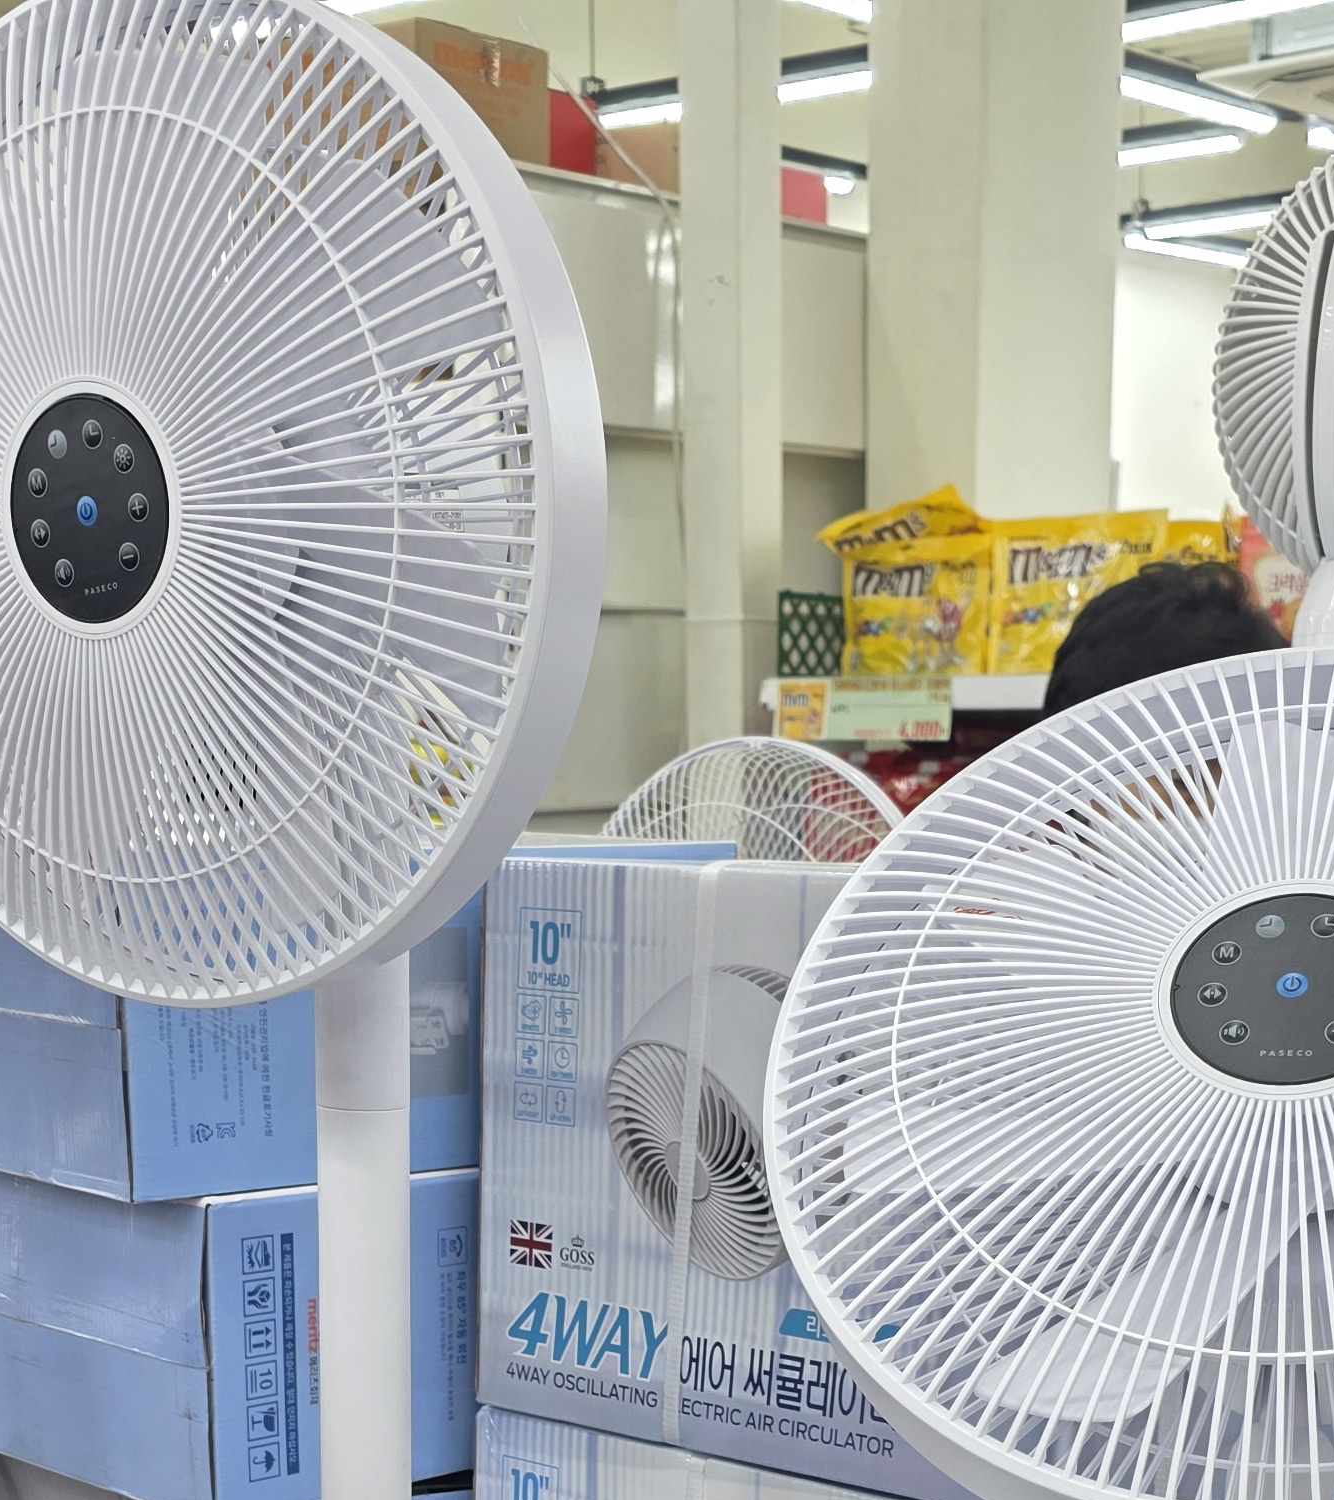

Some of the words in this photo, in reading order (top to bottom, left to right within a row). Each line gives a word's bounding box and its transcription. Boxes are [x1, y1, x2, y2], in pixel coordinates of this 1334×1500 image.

[83, 580, 120, 597] PASECO
[528, 920, 571, 966] 10"
[543, 972, 571, 989] HEAD
[1259, 1048, 1315, 1058] PASECO
[559, 1246, 596, 1267] GOSS
[307, 1297, 319, 1355] meritz
[506, 1290, 669, 1382] 4WAY
[308, 1355, 319, 1406] 메리츠화재
[679, 1335, 736, 1399] 에어
[505, 1364, 552, 1388] 4WAY
[553, 1373, 659, 1410] OSCILLATING
[744, 1409, 775, 1434] AIR
[777, 1418, 896, 1460] CIRCULATOR
